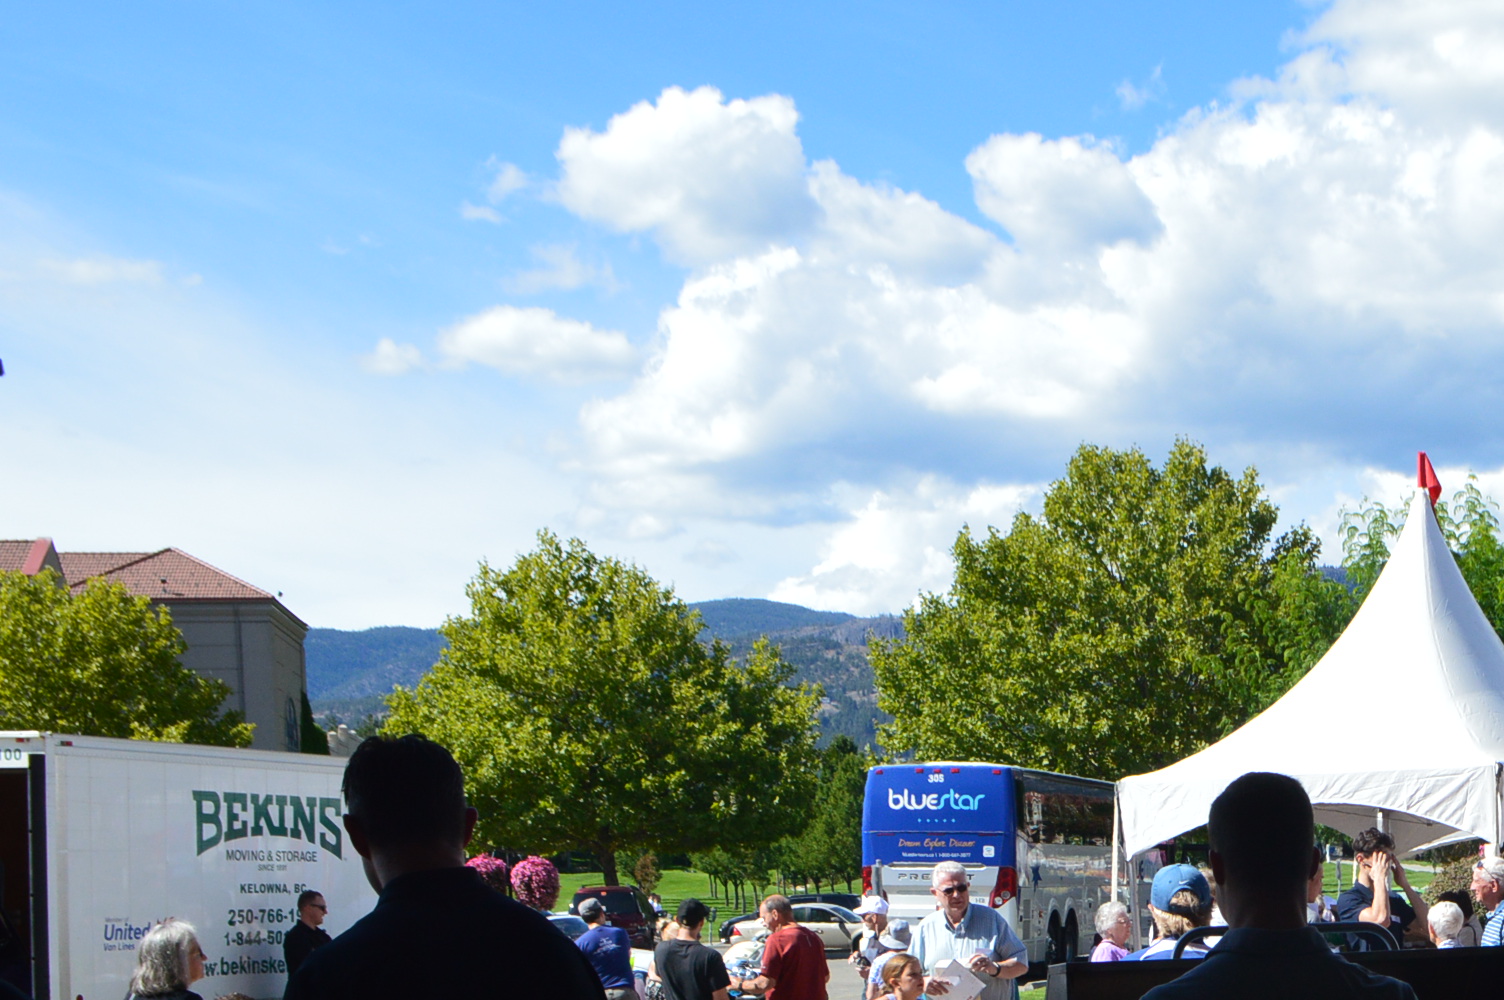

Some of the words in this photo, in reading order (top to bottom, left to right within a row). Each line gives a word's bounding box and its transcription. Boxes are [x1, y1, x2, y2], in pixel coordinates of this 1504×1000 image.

[0, 748, 22, 761] 00
[887, 787, 986, 811] bluestar
[191, 789, 343, 862] BEKINS
[225, 849, 265, 862] MOVING
[267, 850, 274, 861] &
[275, 850, 318, 863] STORAGE
[897, 873, 975, 881] PRET
[239, 883, 291, 896] KELOWNA,
[104, 922, 152, 941] United
[224, 930, 288, 946] 1-844-50
